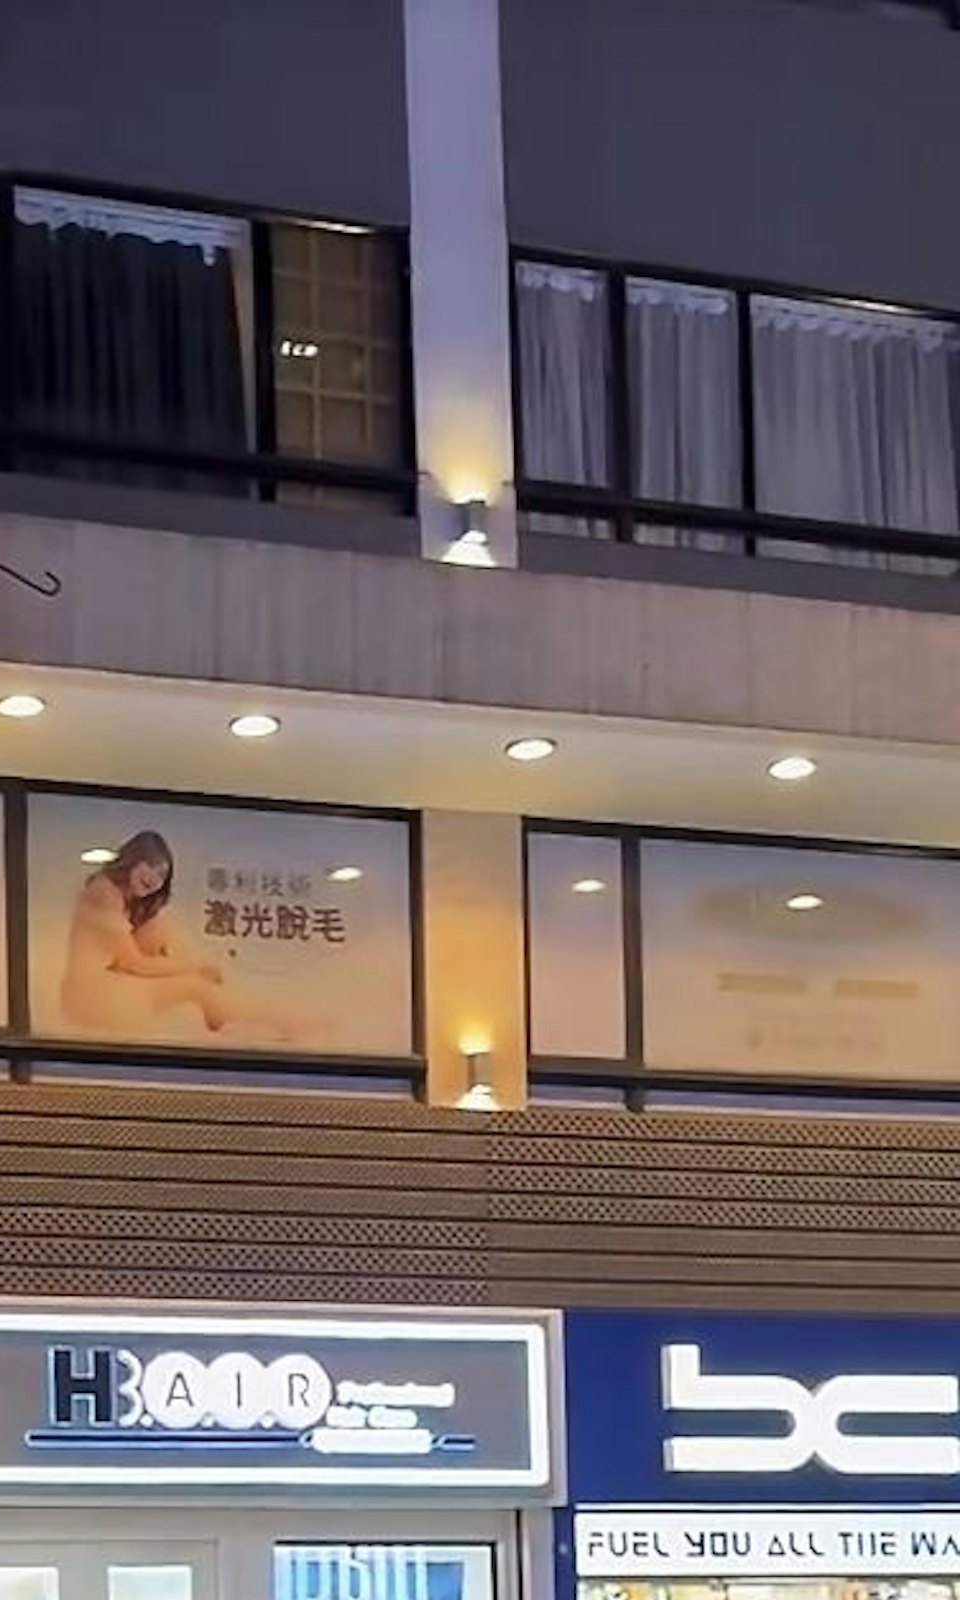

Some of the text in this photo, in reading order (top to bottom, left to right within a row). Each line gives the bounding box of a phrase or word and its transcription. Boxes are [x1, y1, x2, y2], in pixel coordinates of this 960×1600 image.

[588, 1531, 669, 1557] FUEL
[684, 1531, 750, 1557] YOU
[767, 1531, 824, 1557] ALL
[837, 1531, 896, 1557] THE
